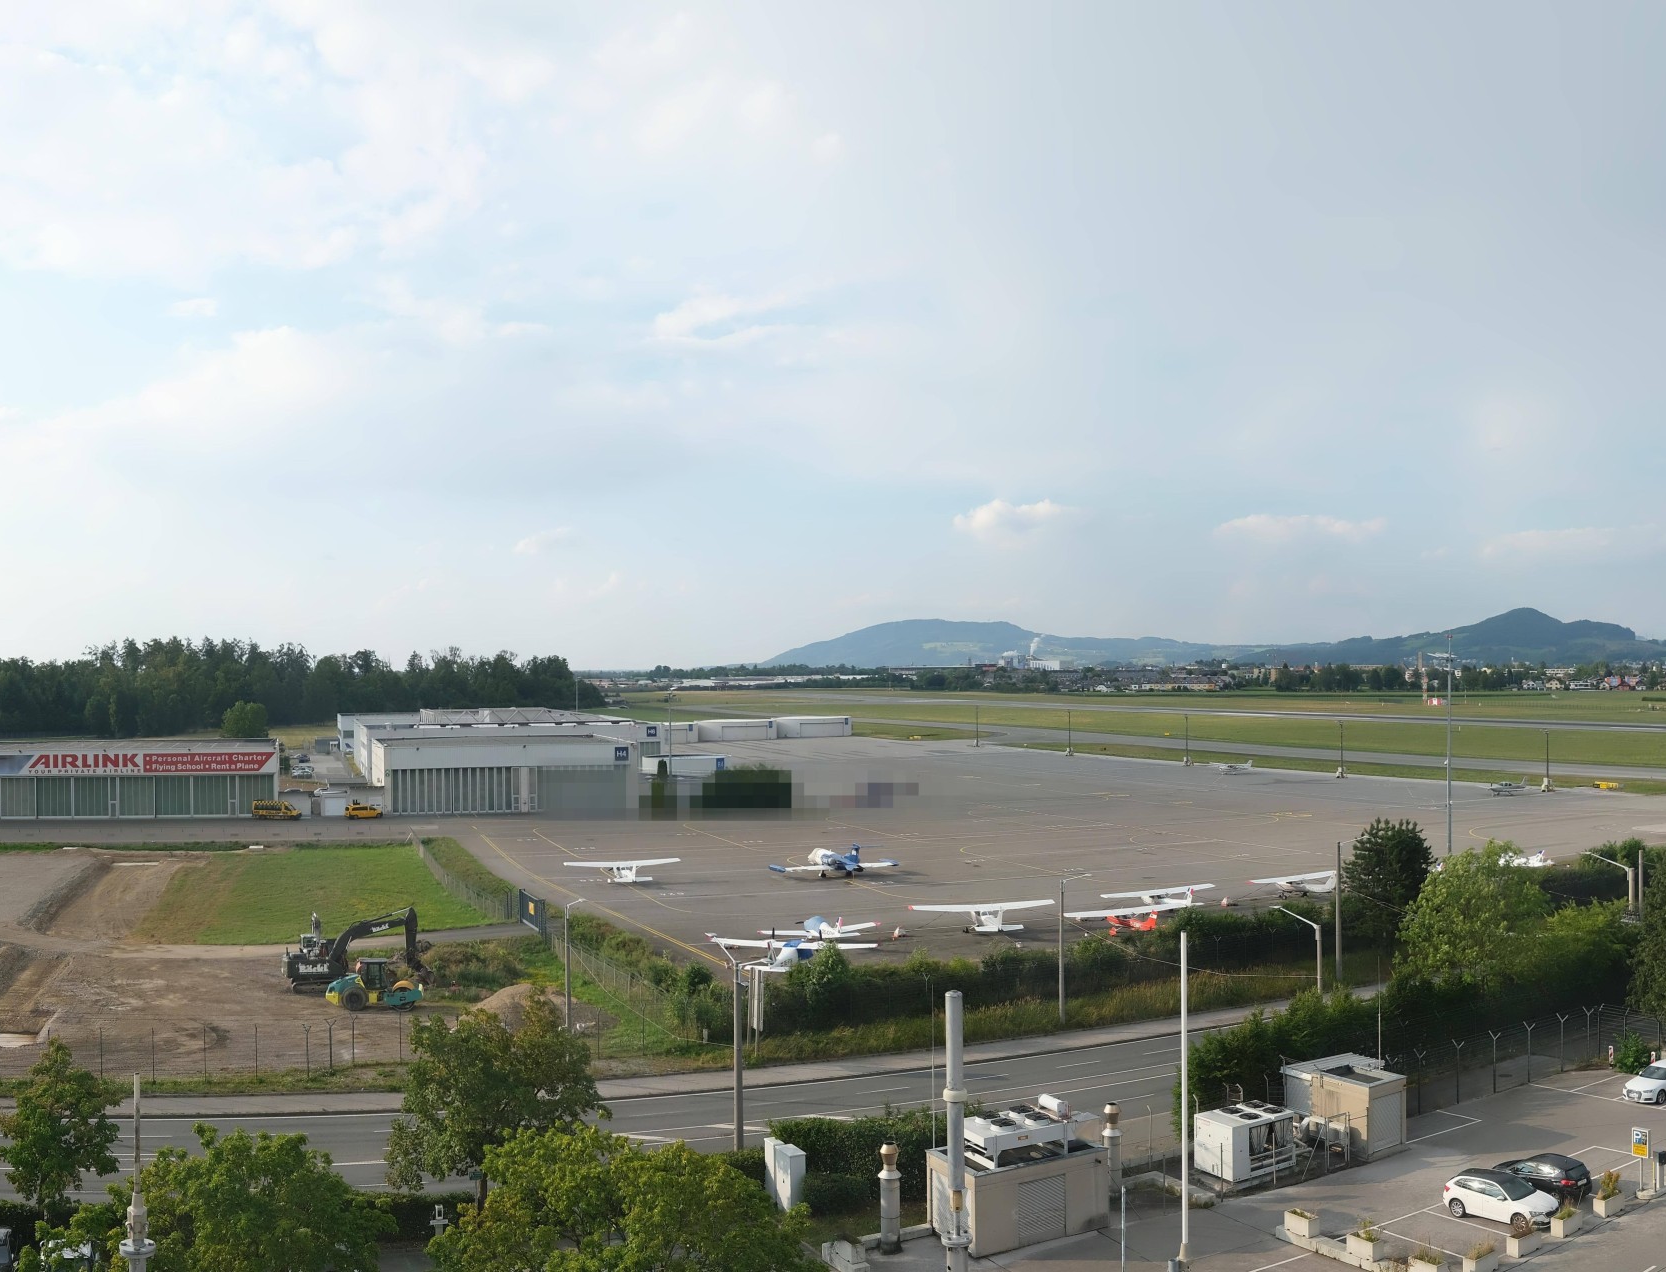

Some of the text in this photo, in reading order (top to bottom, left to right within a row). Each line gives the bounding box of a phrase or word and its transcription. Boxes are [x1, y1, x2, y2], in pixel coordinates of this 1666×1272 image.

[28, 753, 142, 769] AIRLINK
[193, 754, 229, 762] Aircraft
[151, 763, 176, 771] Flying
[236, 762, 259, 770] Plane
[1633, 1130, 1642, 1143] P
